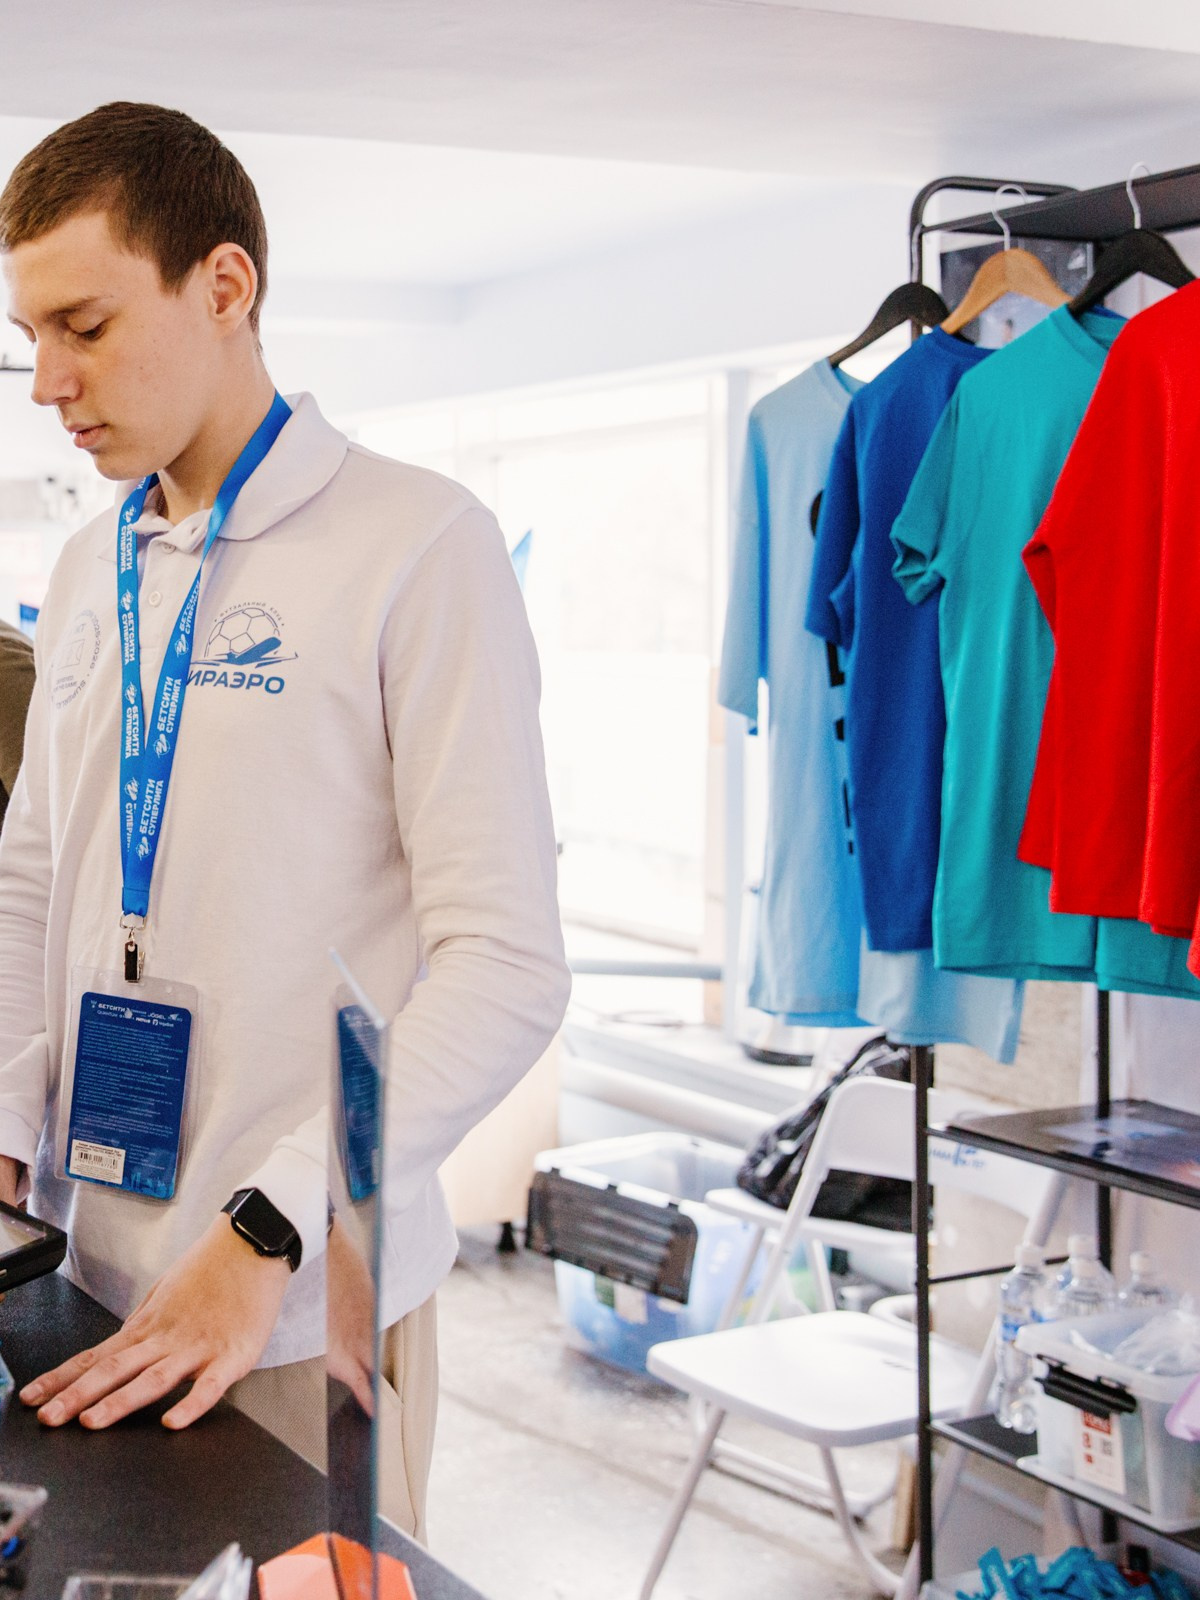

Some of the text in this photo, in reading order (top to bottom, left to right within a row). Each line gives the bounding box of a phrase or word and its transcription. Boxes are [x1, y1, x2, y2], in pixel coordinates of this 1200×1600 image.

[128, 611, 136, 662] БЕТСИТИ
[157, 676, 175, 732] БЕТСИТИ
[166, 678, 182, 734] СУПЕРЛИГА
[186, 669, 286, 695] ИРАЭРО
[132, 705, 140, 757] БЕТСИТИ
[139, 778, 156, 835] БЕТСИТИ
[148, 779, 164, 837] СУПЕРЛИГА
[98, 1003, 126, 1012] БЕТСИТИ
